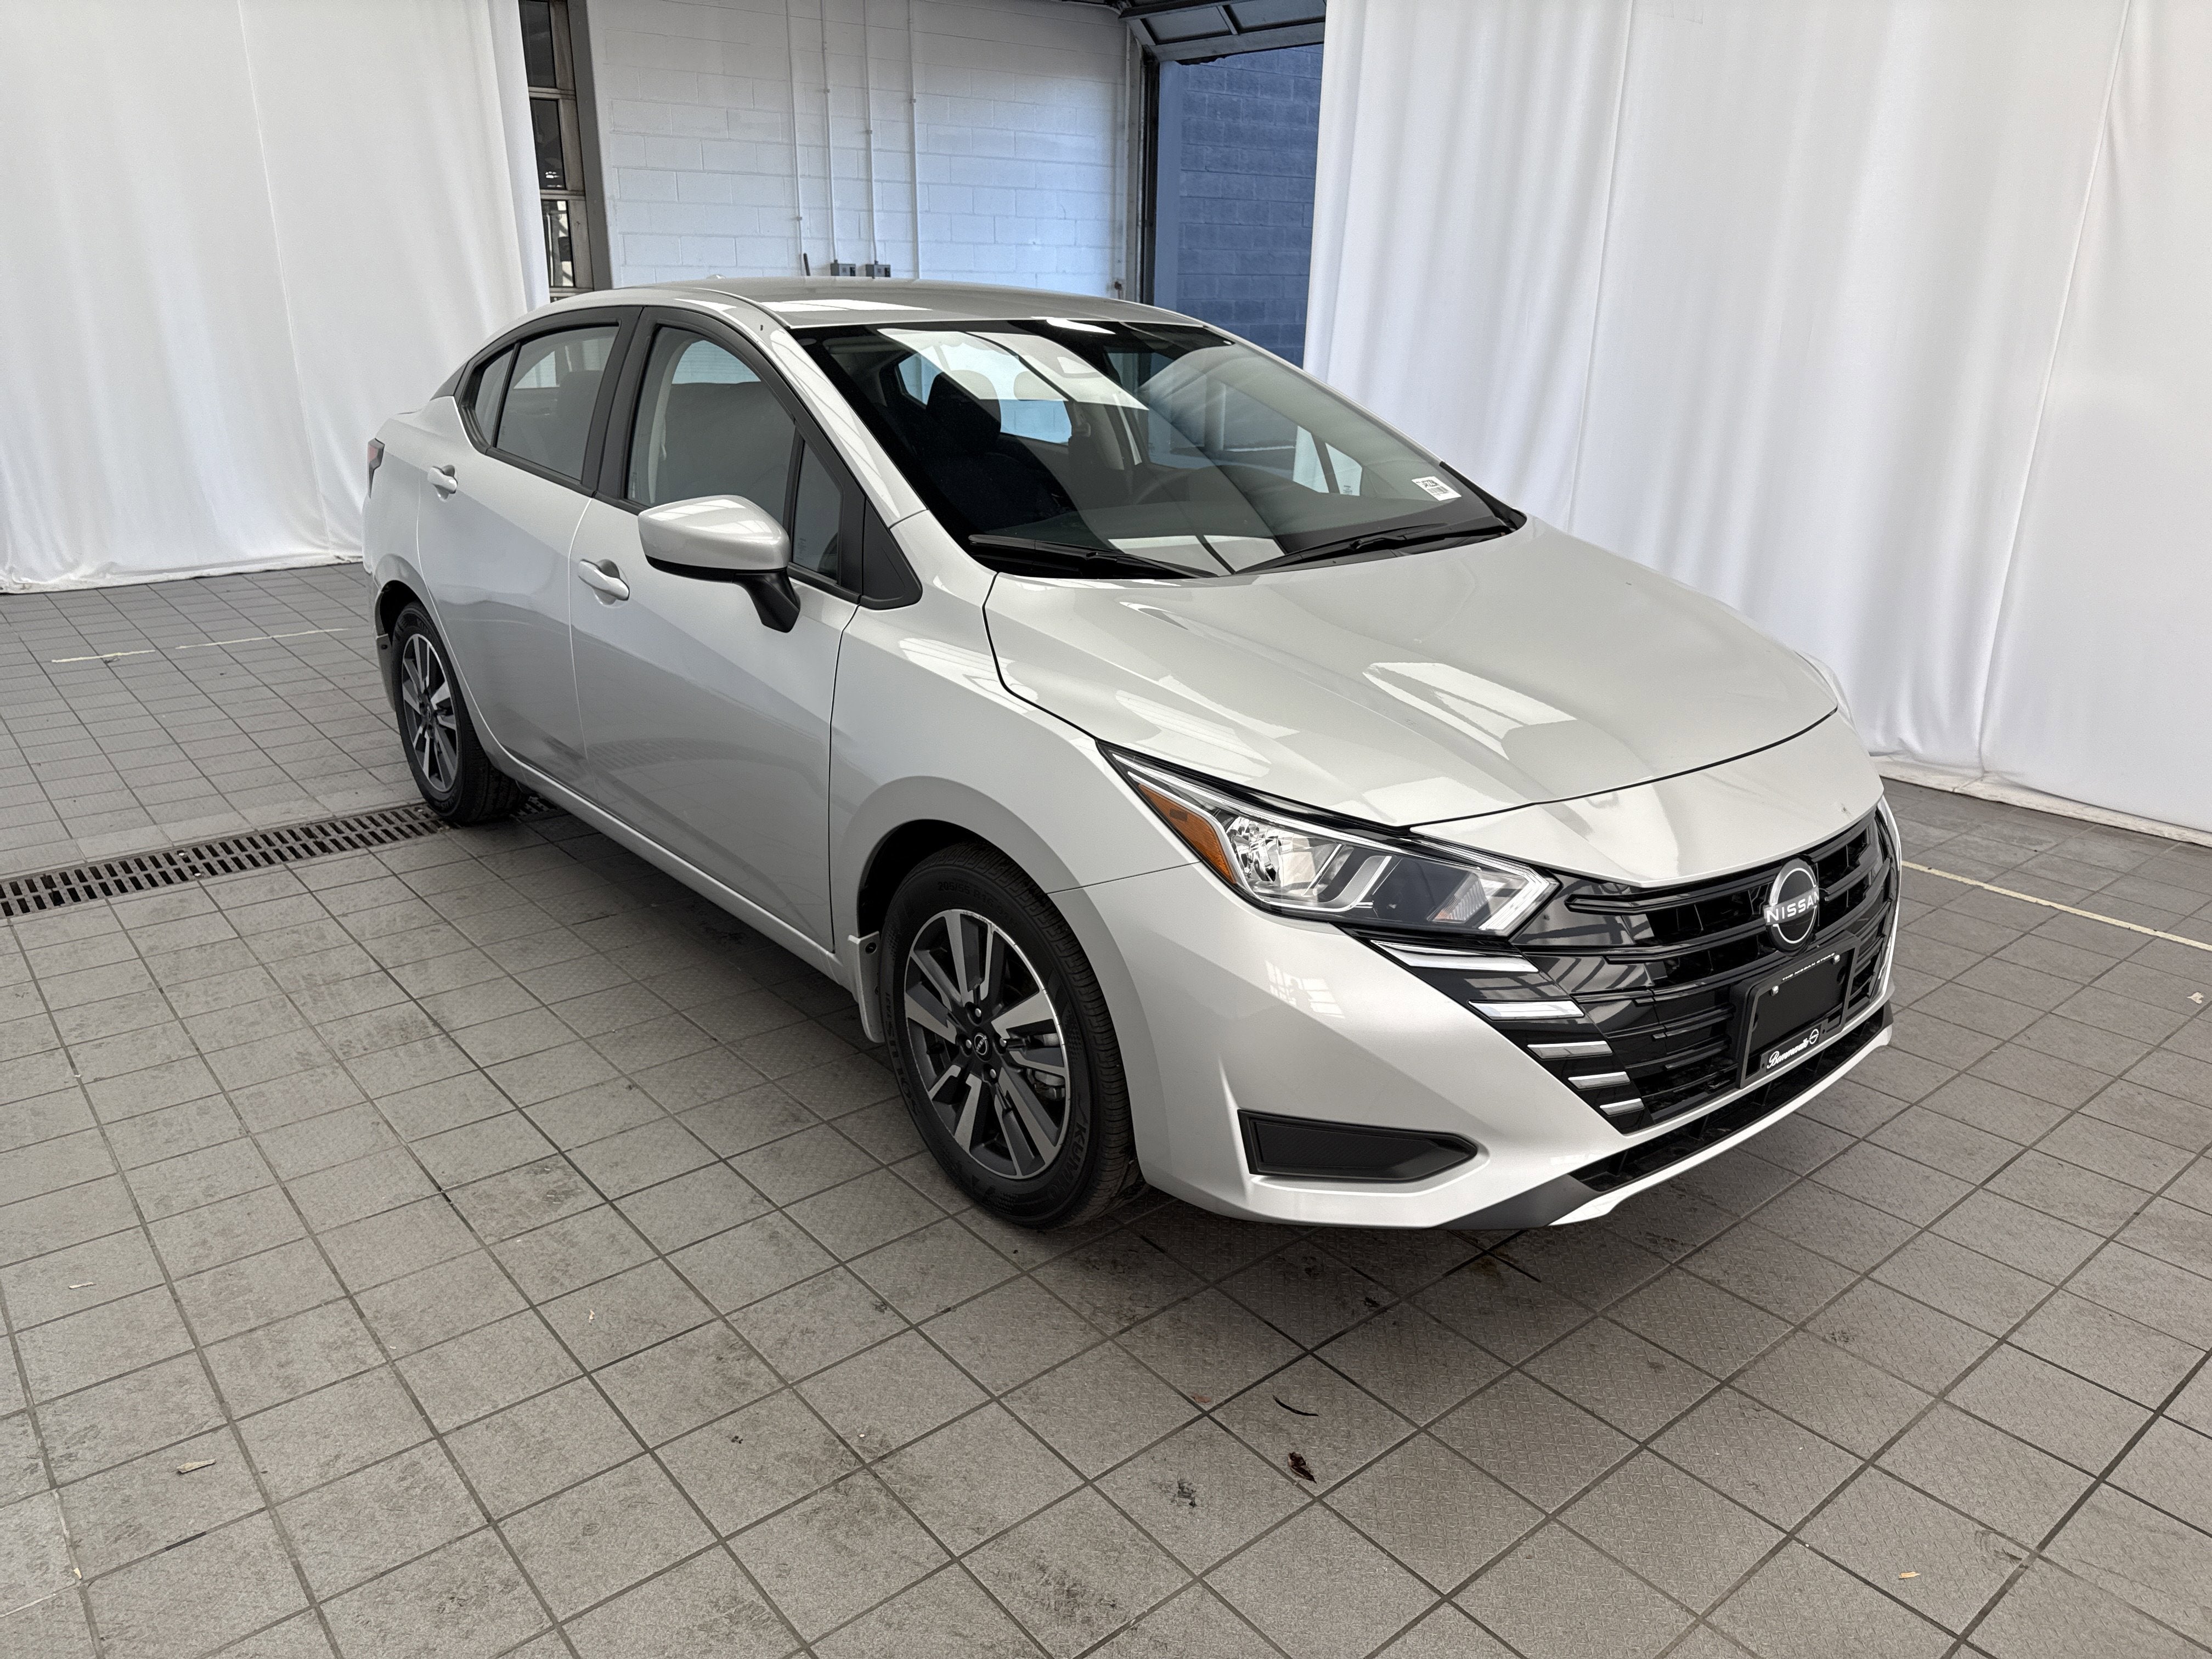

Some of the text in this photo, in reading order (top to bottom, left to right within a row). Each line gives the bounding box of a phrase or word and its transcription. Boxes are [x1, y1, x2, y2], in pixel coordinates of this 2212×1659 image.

[1766, 891, 1820, 923] NISSAN
[1795, 962, 1815, 975] NISSAN
[1816, 952, 1835, 964] STORE
[1046, 1121, 1087, 1201] KUMHO
